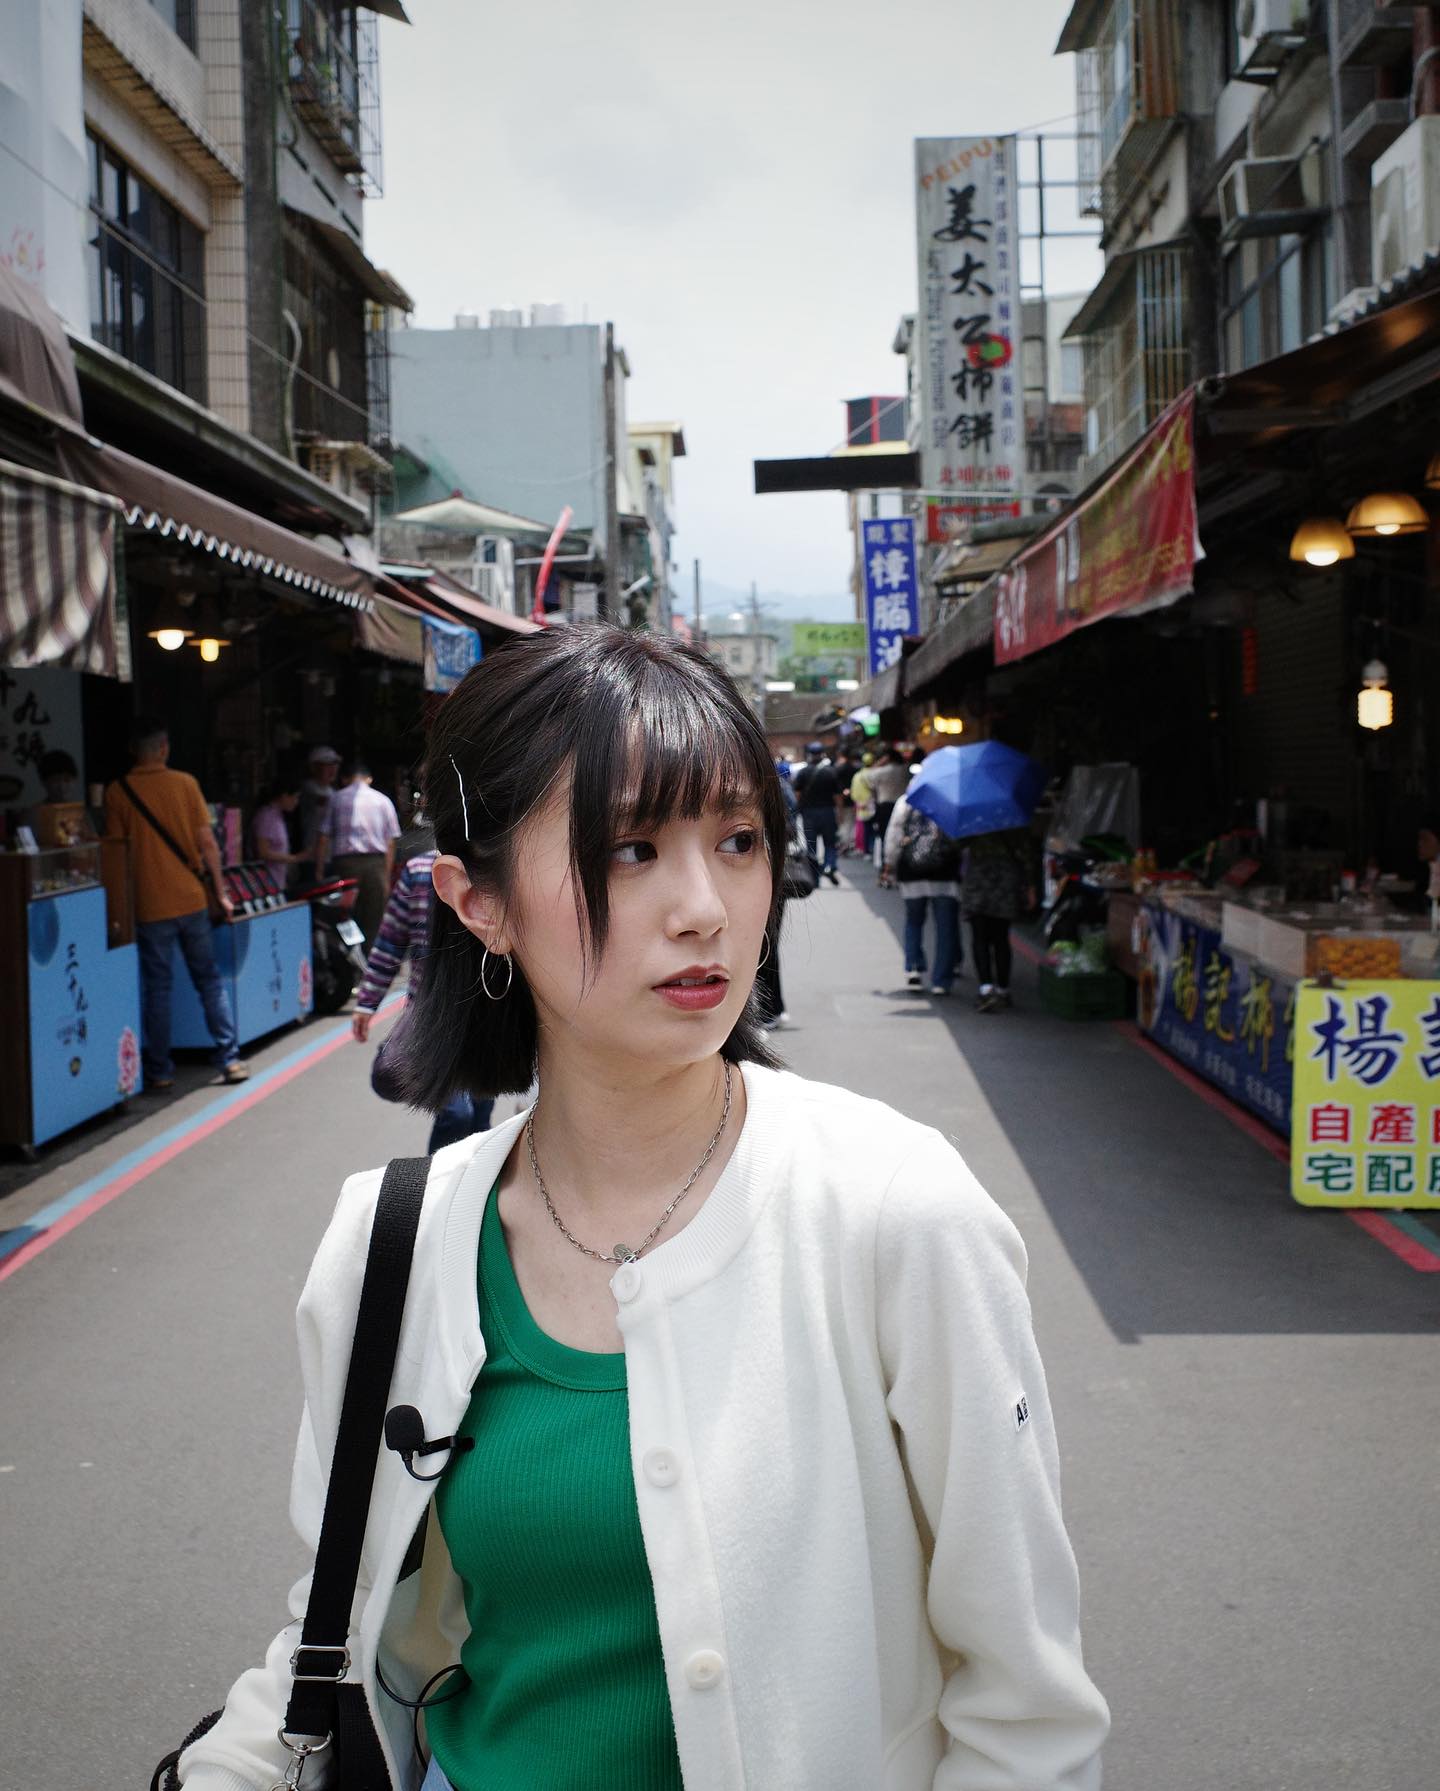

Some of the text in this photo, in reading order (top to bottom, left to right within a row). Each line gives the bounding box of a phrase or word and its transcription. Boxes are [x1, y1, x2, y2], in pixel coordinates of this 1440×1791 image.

[921, 137, 993, 190] PEIPU
[1311, 1103, 1440, 1143] 自產
[1306, 1153, 1440, 1194] 宅配
